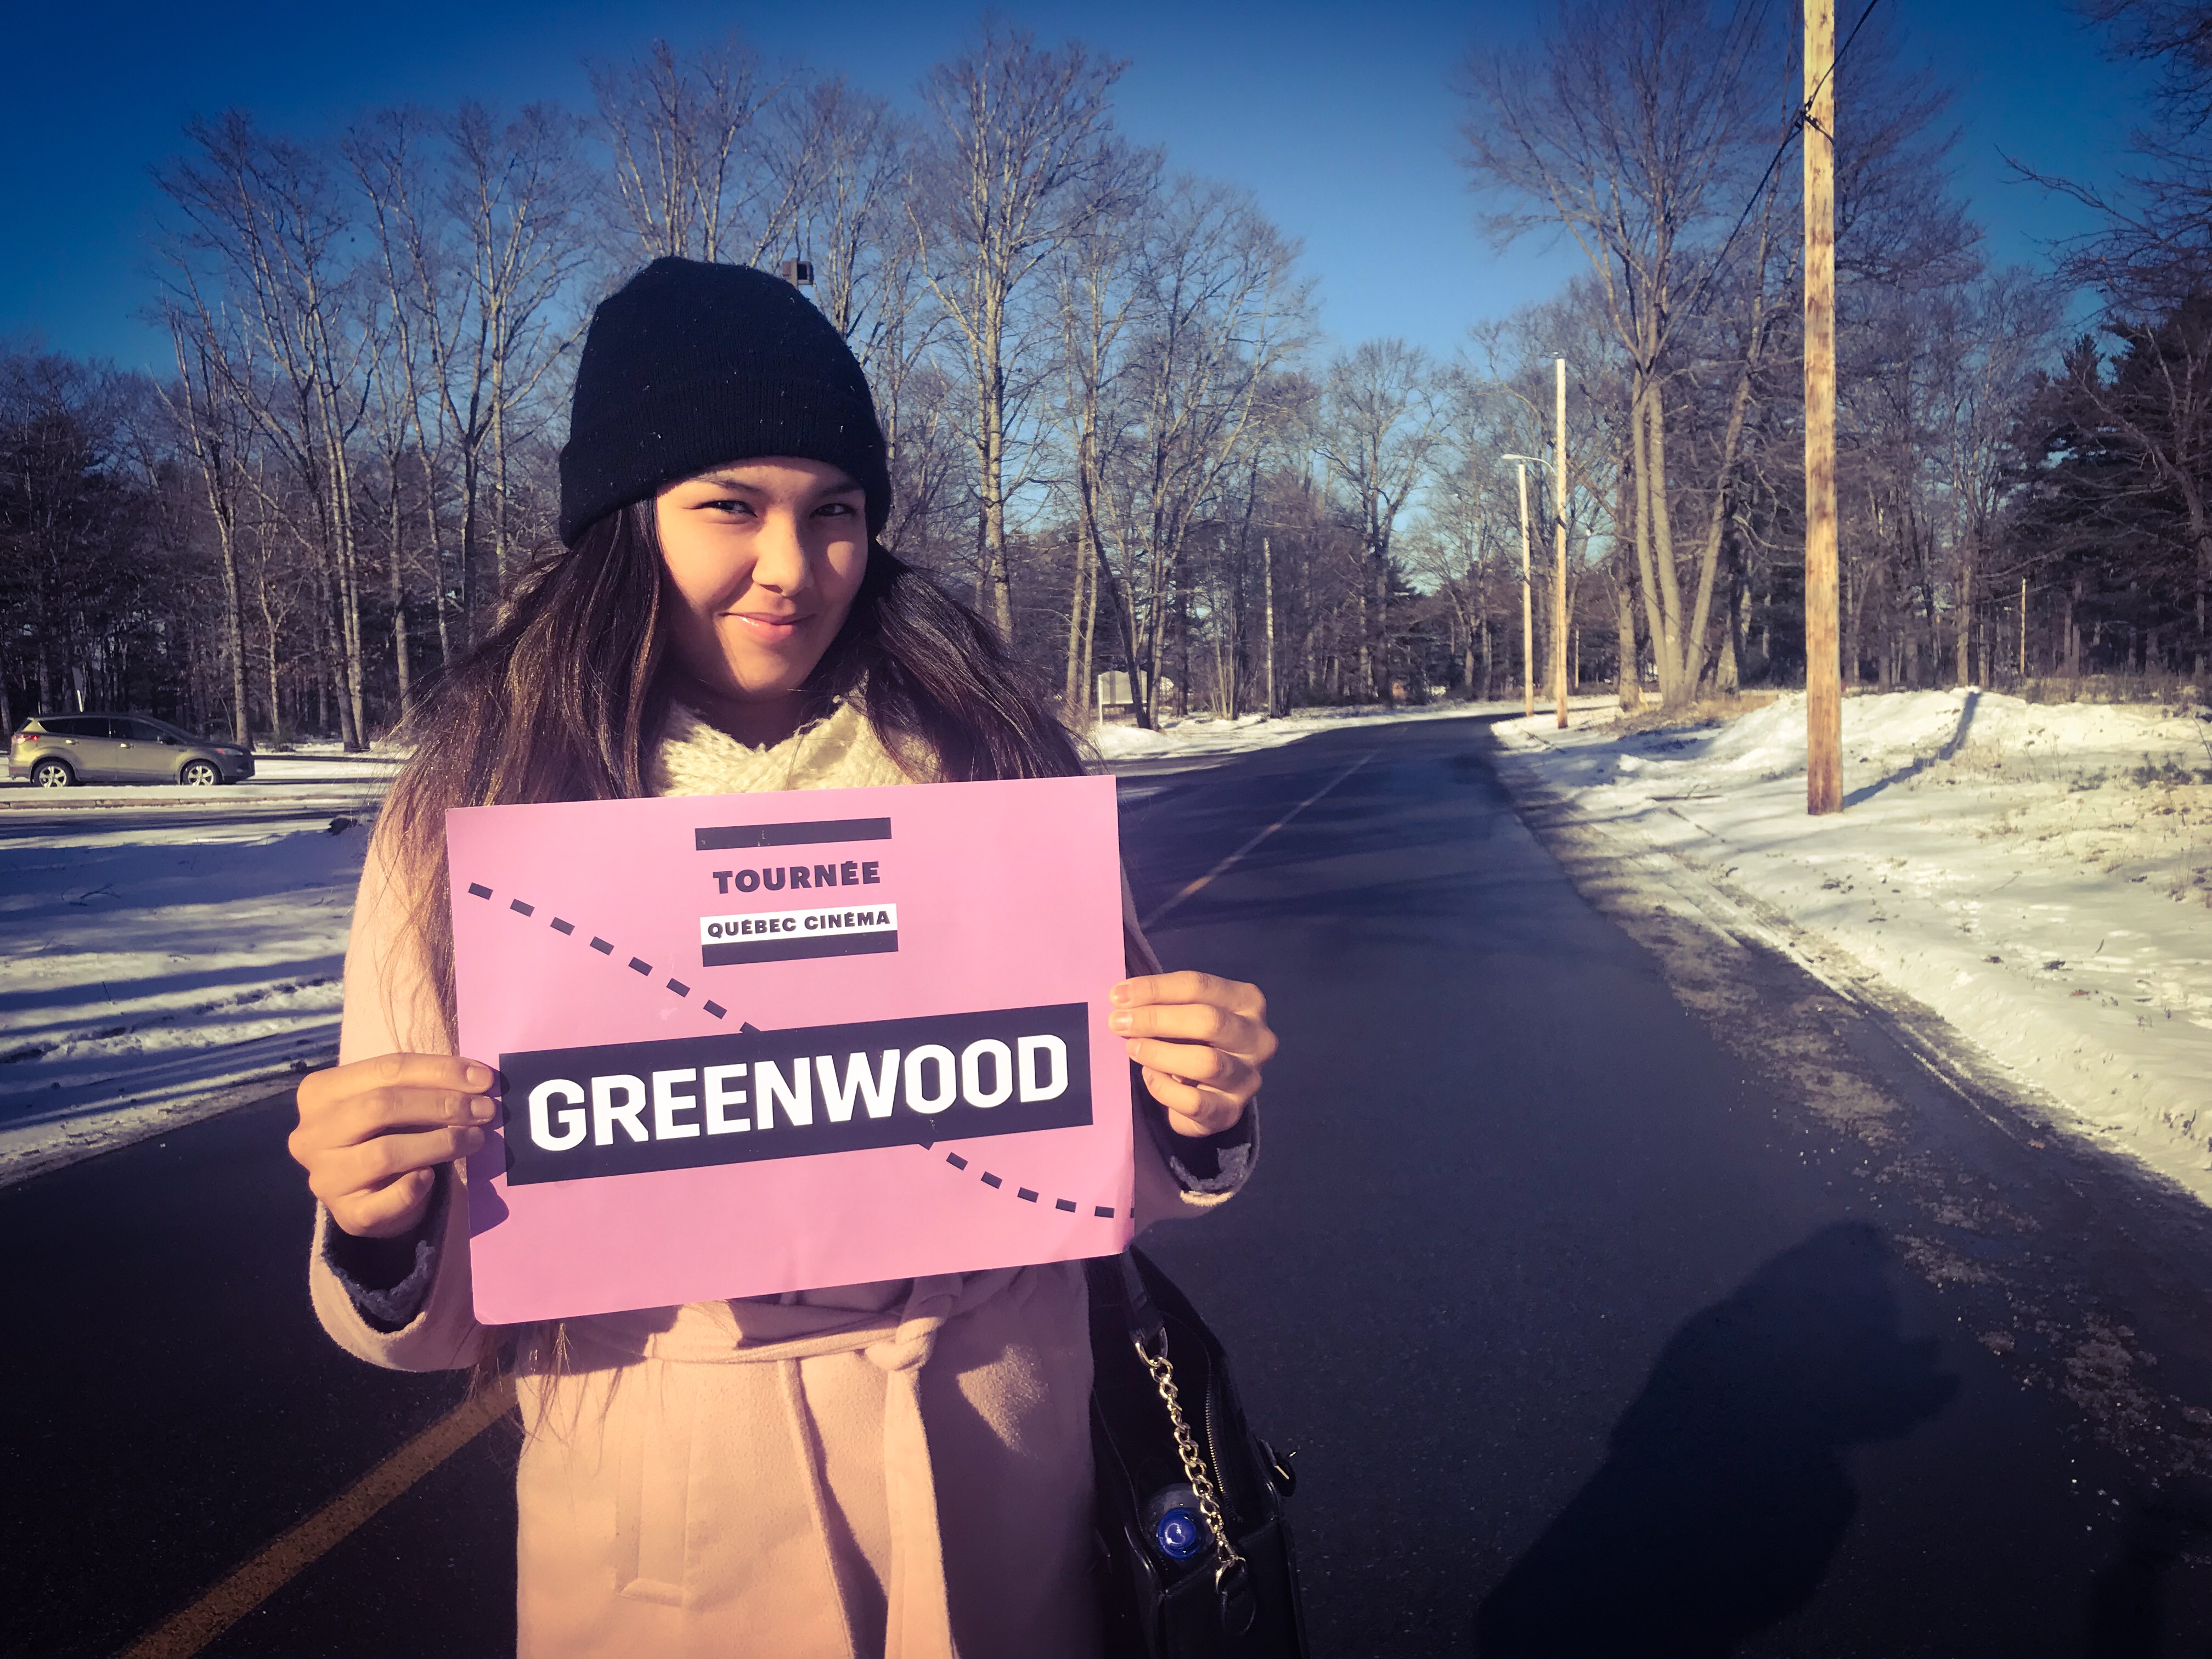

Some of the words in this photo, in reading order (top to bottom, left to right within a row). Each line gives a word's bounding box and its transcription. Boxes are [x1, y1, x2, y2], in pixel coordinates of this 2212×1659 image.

[713, 860, 881, 894] TOURNÉE
[708, 917, 797, 939] QUÉBEC
[804, 911, 891, 931] CINÉMA
[528, 1034, 1069, 1153] GREENWOOD
